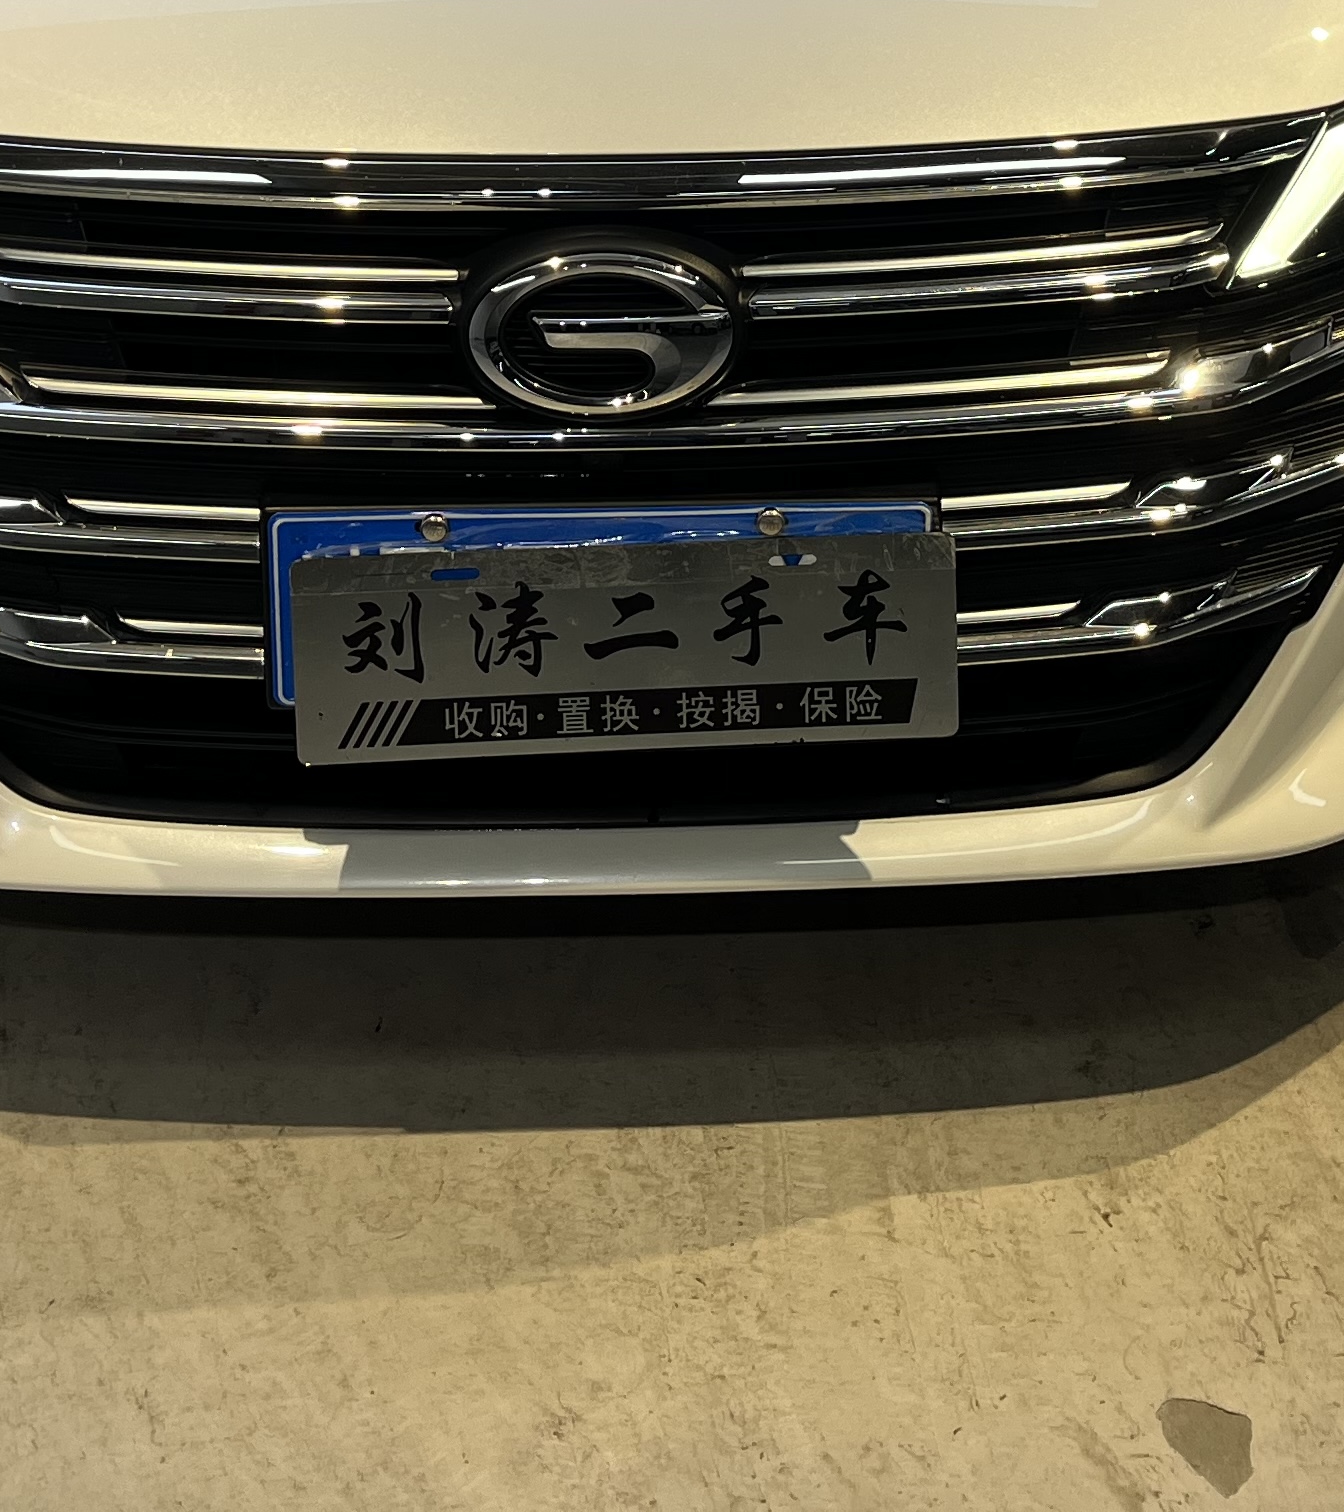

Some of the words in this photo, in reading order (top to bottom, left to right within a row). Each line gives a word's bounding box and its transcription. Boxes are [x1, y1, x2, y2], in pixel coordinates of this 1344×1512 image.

[343, 570, 908, 684] 刘涛二手车
